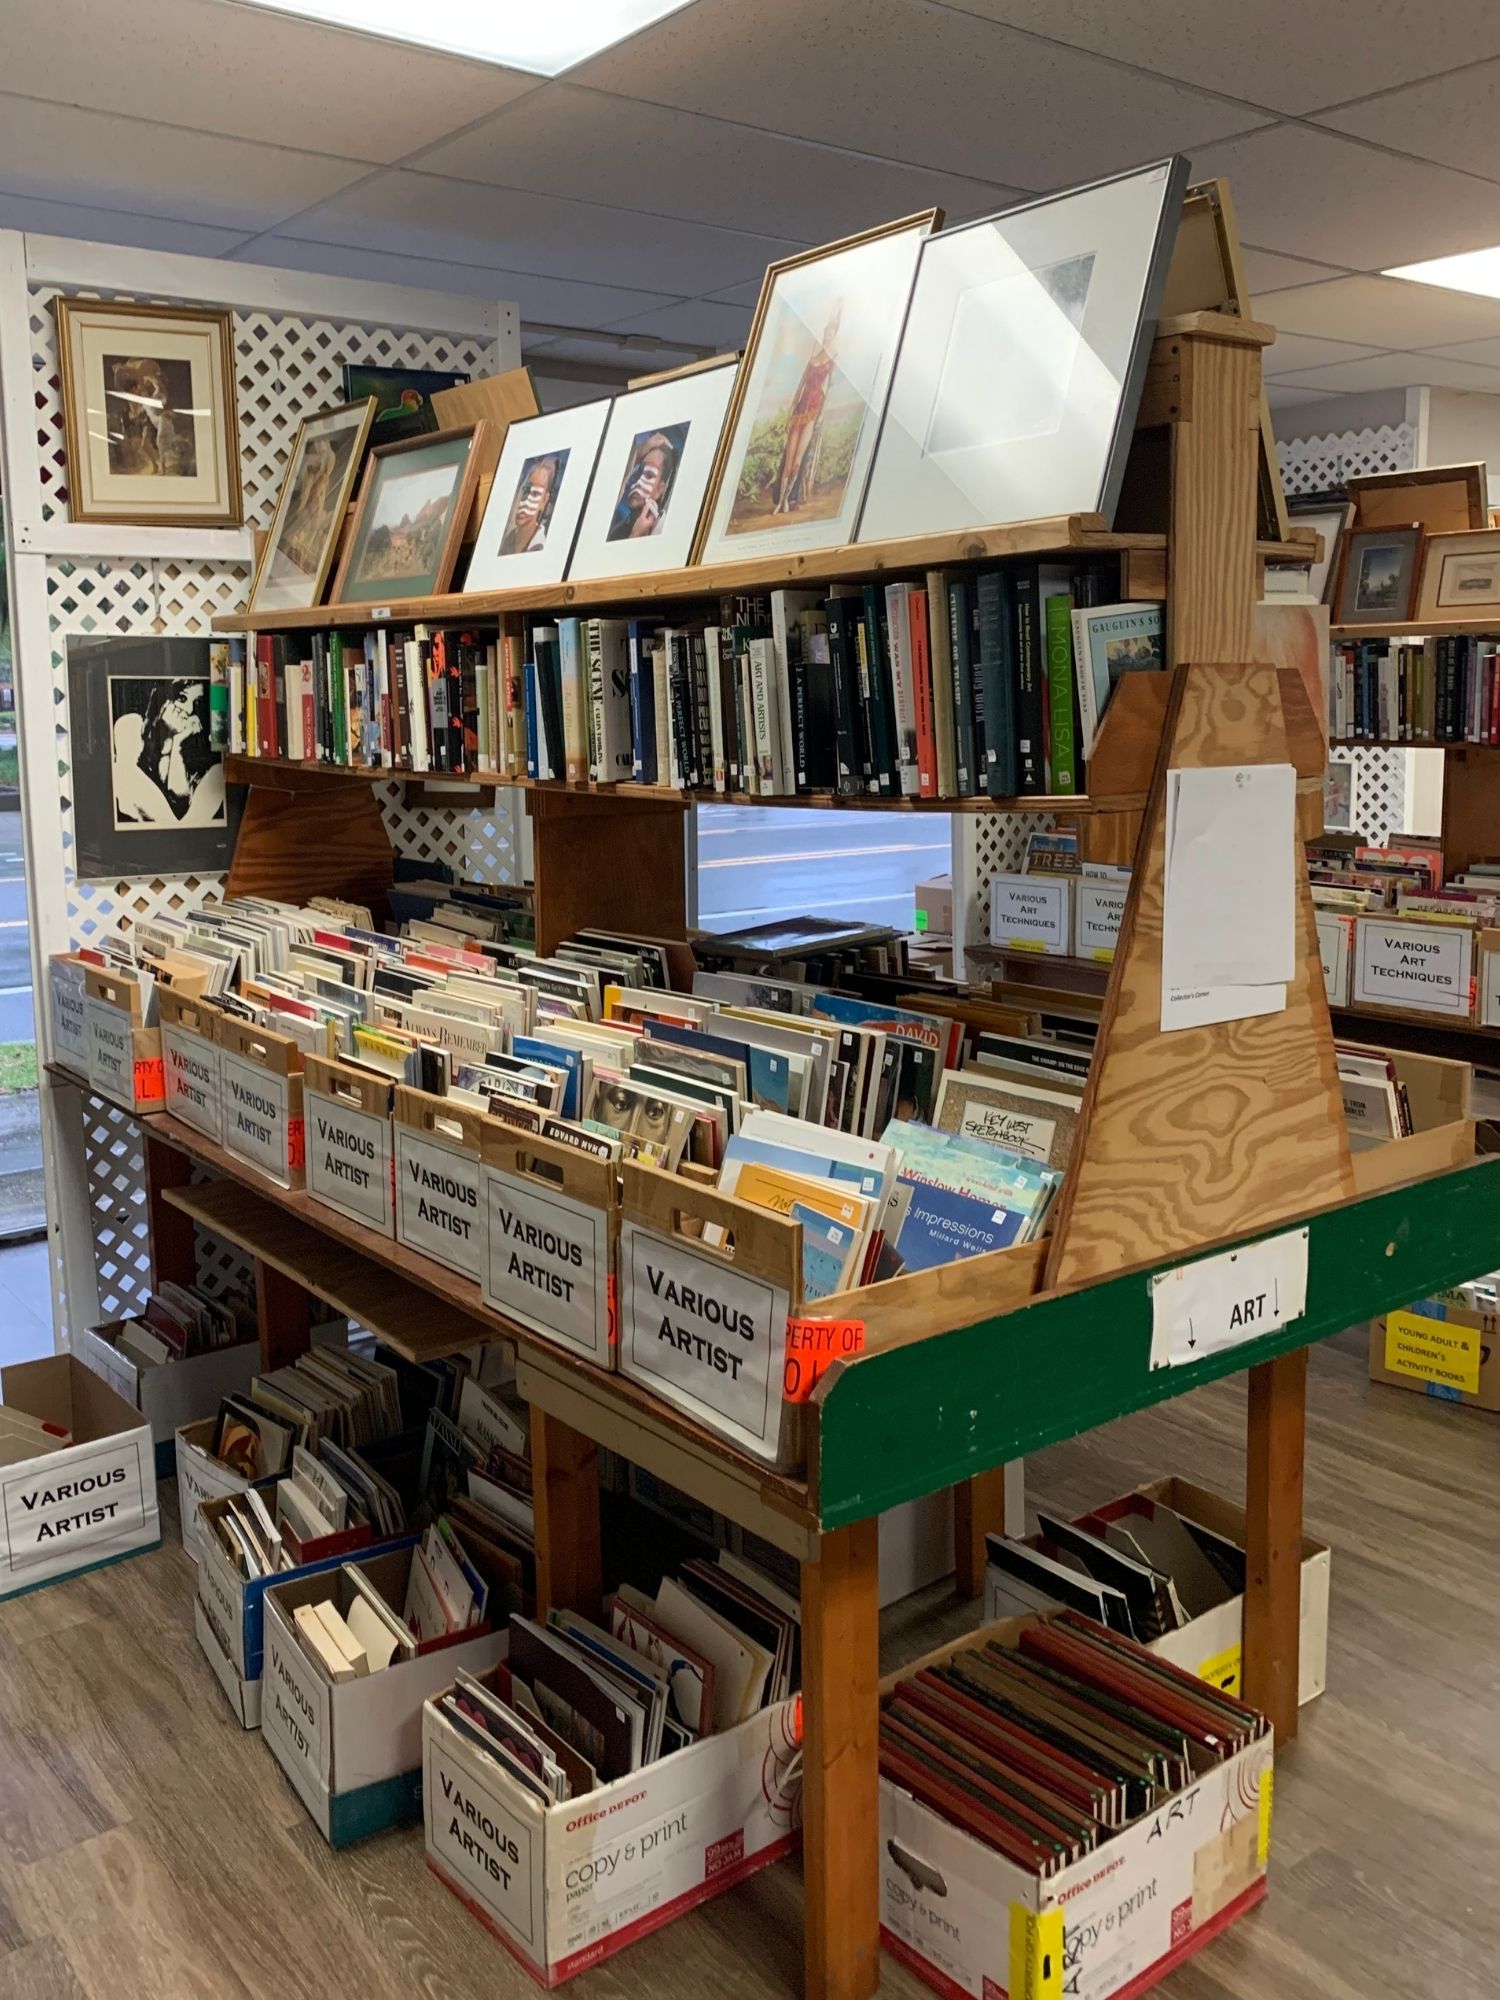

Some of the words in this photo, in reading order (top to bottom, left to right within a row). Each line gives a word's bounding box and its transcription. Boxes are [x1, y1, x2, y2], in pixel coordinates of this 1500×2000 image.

[736, 597, 764, 612] THE
[588, 622, 601, 654] THE
[953, 646, 959, 660] OR
[1051, 626, 1068, 696] MONA
[591, 658, 604, 704] SCENE
[756, 677, 764, 700] AND
[676, 700, 686, 738] PERFECT
[681, 740, 690, 773] WORLD
[758, 701, 766, 740] ARTISTS
[1054, 709, 1070, 756] LISA
[1010, 892, 1047, 904] VARIOUS
[1020, 905, 1038, 914] ART
[1096, 898, 1125, 910] VARIO
[1001, 914, 1056, 929] TECHNIQUES
[1086, 921, 1119, 933] TECHN
[1107, 912, 1122, 921] AR
[1384, 938, 1440, 954] VARIOUS
[1400, 954, 1426, 967] ART
[1371, 964, 1452, 986] TECHNIQUES
[56, 990, 84, 1016] VARIOUS
[60, 1014, 83, 1038] ARTIST
[92, 1021, 125, 1050] VARIOUS
[405, 1020, 437, 1039] ALWAYS
[440, 1026, 488, 1052] REMEMBER
[896, 1024, 938, 1048] DAVID
[97, 1047, 122, 1073] ARTIST
[170, 1049, 210, 1084] VARIOUS
[177, 1078, 207, 1108] ARTIST
[231, 1080, 276, 1119] VARIOUS
[237, 1112, 272, 1146] ARTIST
[984, 1110, 1005, 1126] KEY
[317, 1118, 374, 1160] VARIOUS
[549, 1128, 580, 1146] EDVARD
[324, 1153, 370, 1189] ARTIST
[408, 1159, 478, 1208] VARIOUS
[902, 1167, 956, 1193] Winslow
[418, 1198, 471, 1240] ARTIST
[914, 1206, 994, 1244] Impressions
[498, 1208, 583, 1267] VARIOUS
[929, 1230, 960, 1246] Millard
[962, 1241, 988, 1254] Wells
[508, 1252, 574, 1304] ARTIST
[646, 1265, 754, 1342] VARIOUS
[1230, 1293, 1267, 1330] ART
[658, 1316, 743, 1381] ARTIST
[842, 1326, 864, 1352] OF
[1397, 1342, 1446, 1362] CHILDREN'S
[1398, 1326, 1428, 1340] YOUNG
[1430, 1336, 1458, 1348] ADULT
[1460, 1341, 1470, 1352] &
[1396, 1358, 1434, 1375] ACTIVITY
[1435, 1368, 1465, 1382] BOOKS
[21, 1468, 126, 1511] VARIOUS
[36, 1502, 119, 1543] ARTIST
[271, 1642, 315, 1726] VARIOUS
[275, 1694, 310, 1760] ARTIST
[439, 1772, 520, 1864] VARIOUS
[565, 1809, 606, 1834] Office
[608, 1790, 648, 1816] DEPOT
[1146, 1786, 1201, 1844] ART
[449, 1817, 512, 1891] ARTIST
[566, 1847, 621, 1890] copy
[624, 1842, 636, 1862] &
[641, 1811, 689, 1862] print
[1058, 1878, 1092, 1906] Office
[1092, 1856, 1126, 1884] DEPOT
[1117, 1876, 1158, 1923] print
[928, 1908, 962, 1944] print
